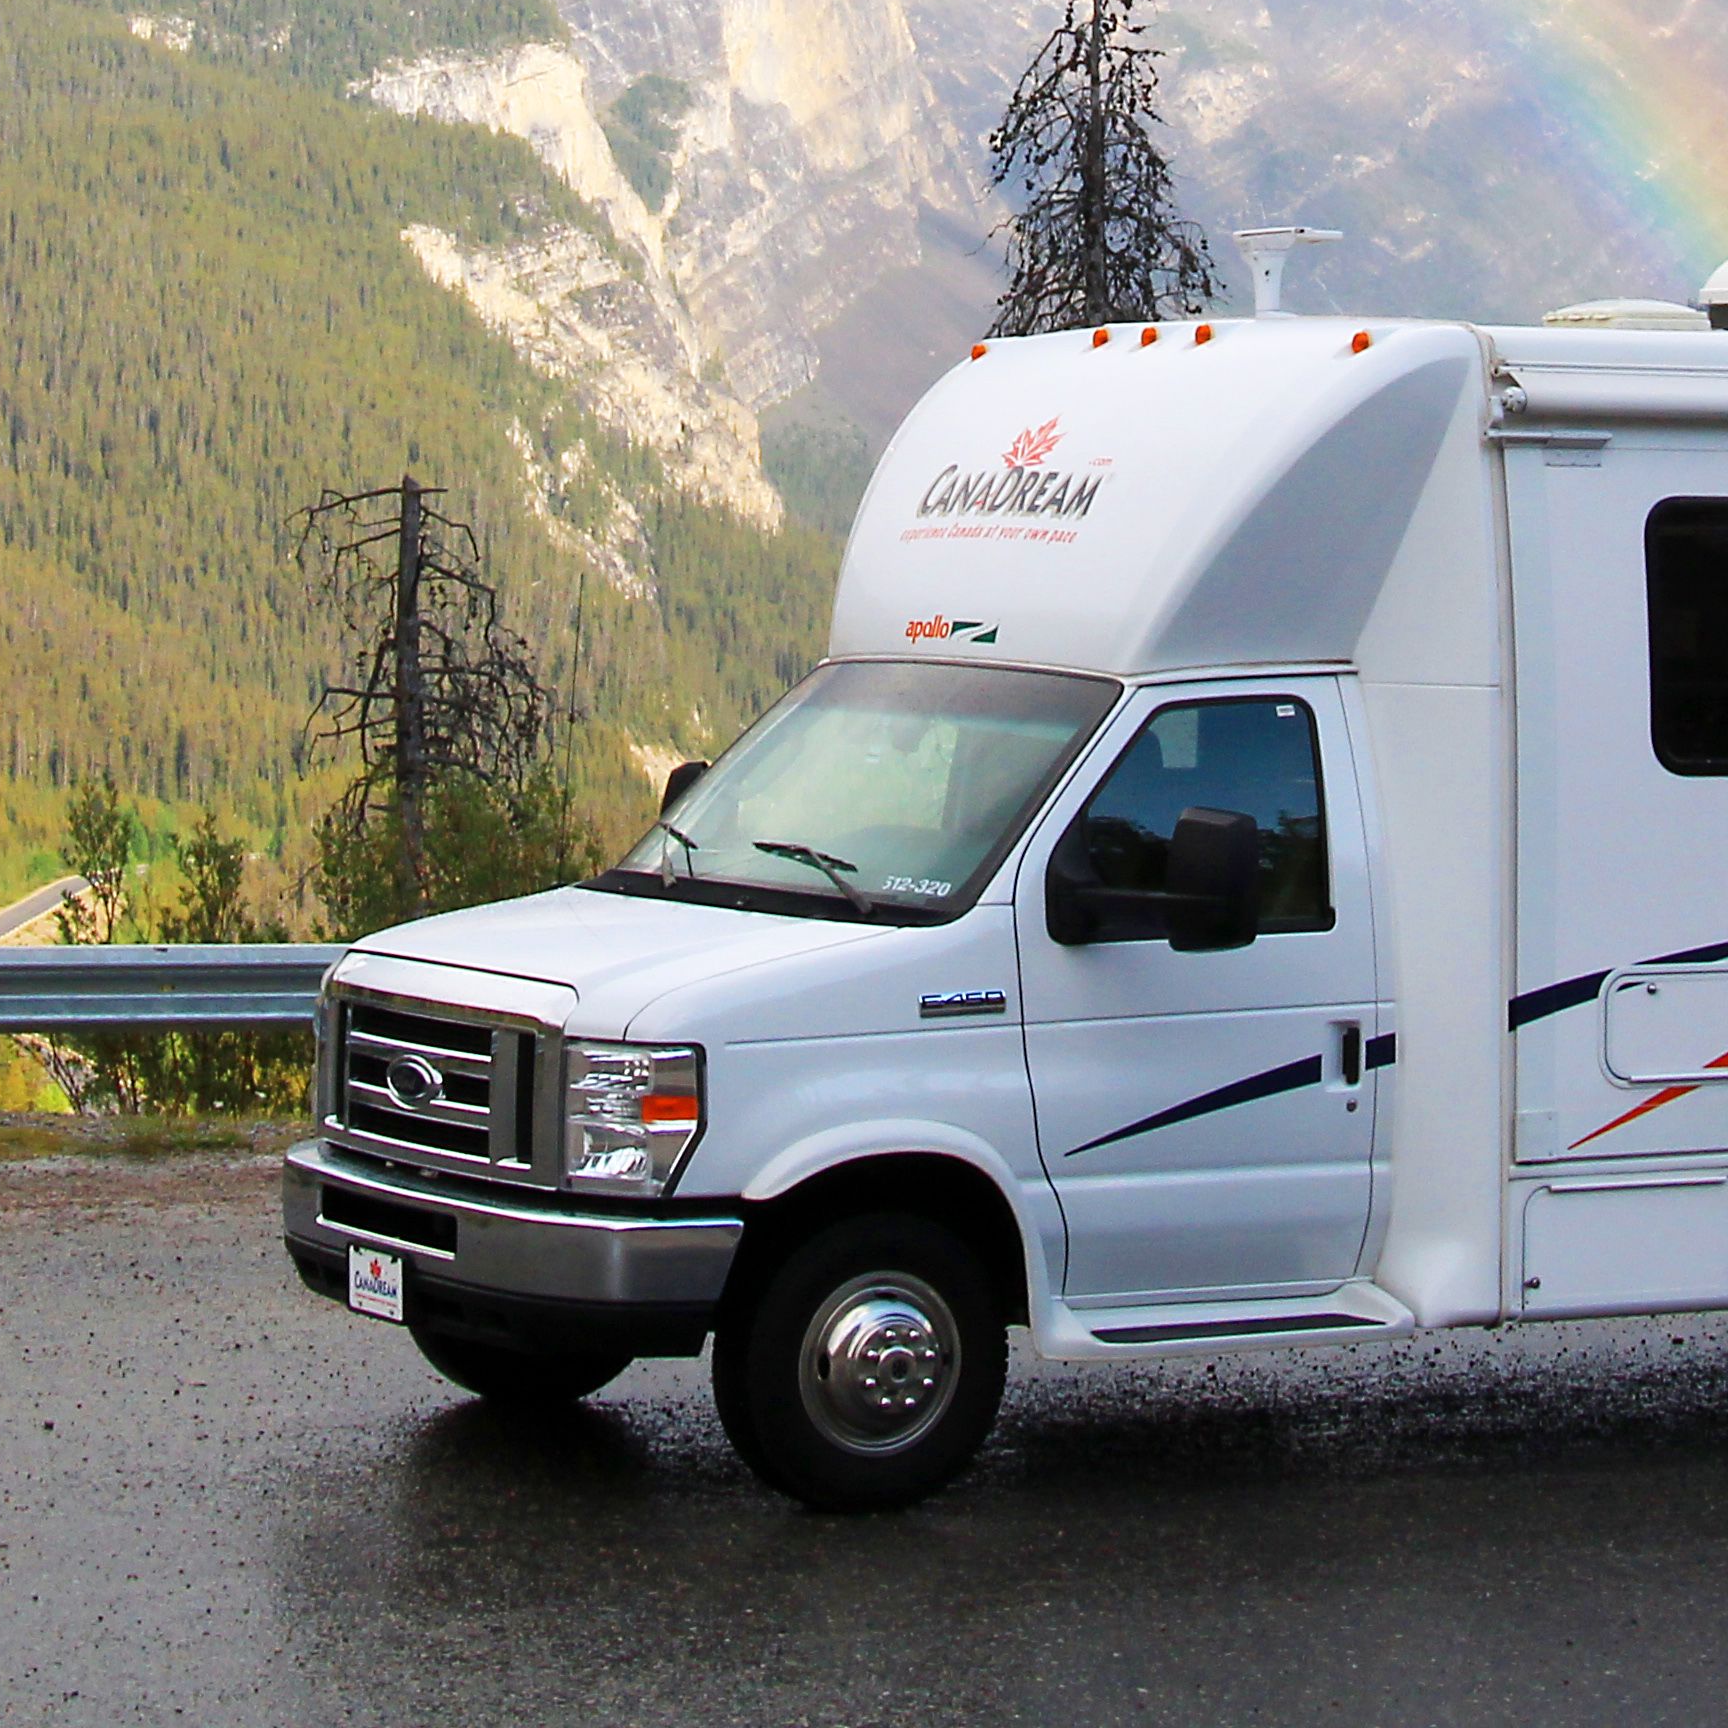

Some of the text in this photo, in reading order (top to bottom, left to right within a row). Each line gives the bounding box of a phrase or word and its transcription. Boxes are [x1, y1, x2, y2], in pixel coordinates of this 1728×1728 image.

[918, 464, 1104, 517] CANADREAM
[948, 522, 983, 538] Canada
[983, 524, 1000, 538] at
[995, 527, 1024, 542] your
[1024, 528, 1049, 541] own
[1046, 529, 1078, 545] pace
[905, 614, 950, 644] apollo
